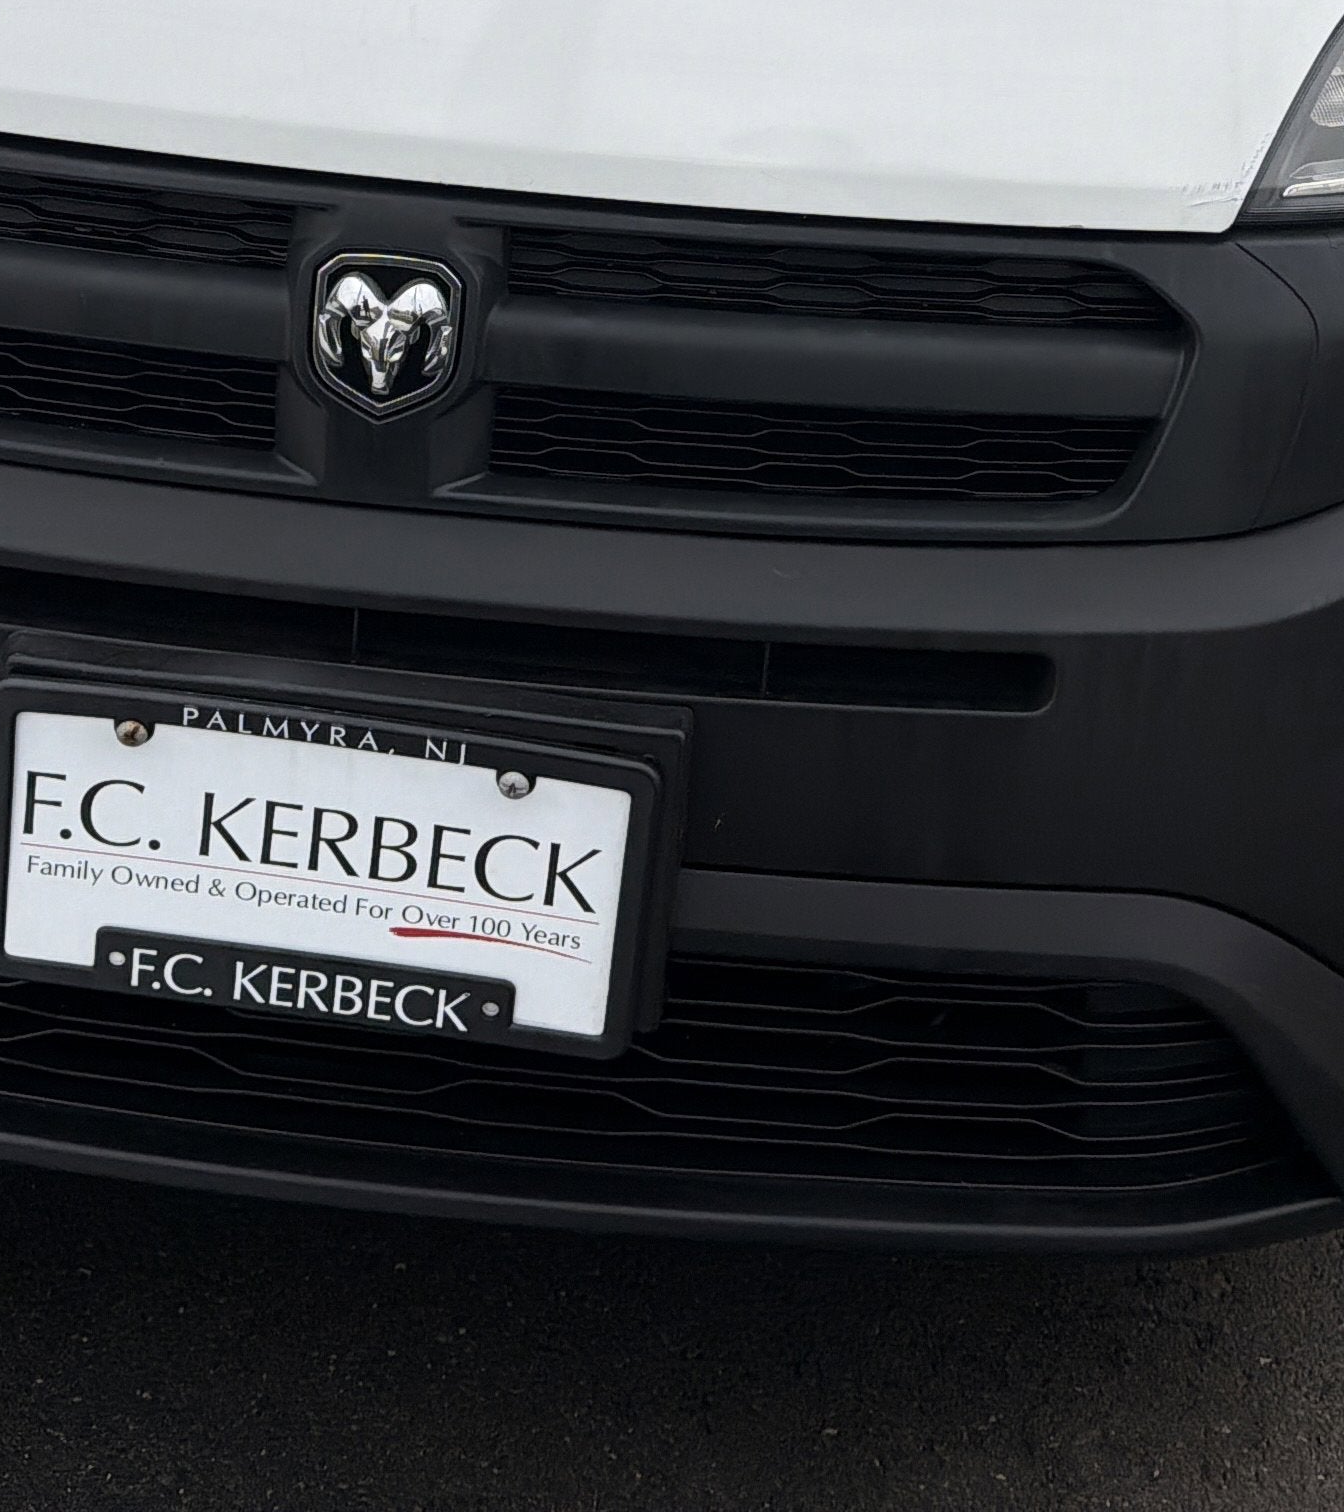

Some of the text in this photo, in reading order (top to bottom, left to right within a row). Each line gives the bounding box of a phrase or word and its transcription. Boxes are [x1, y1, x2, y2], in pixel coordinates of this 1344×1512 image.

[424, 738, 467, 766] NJ
[22, 770, 603, 915] F.C. KERBECK
[26, 855, 582, 950] Family Owned & Operated For Over 100 Years
[129, 946, 471, 1032] F.C. KERBECK
